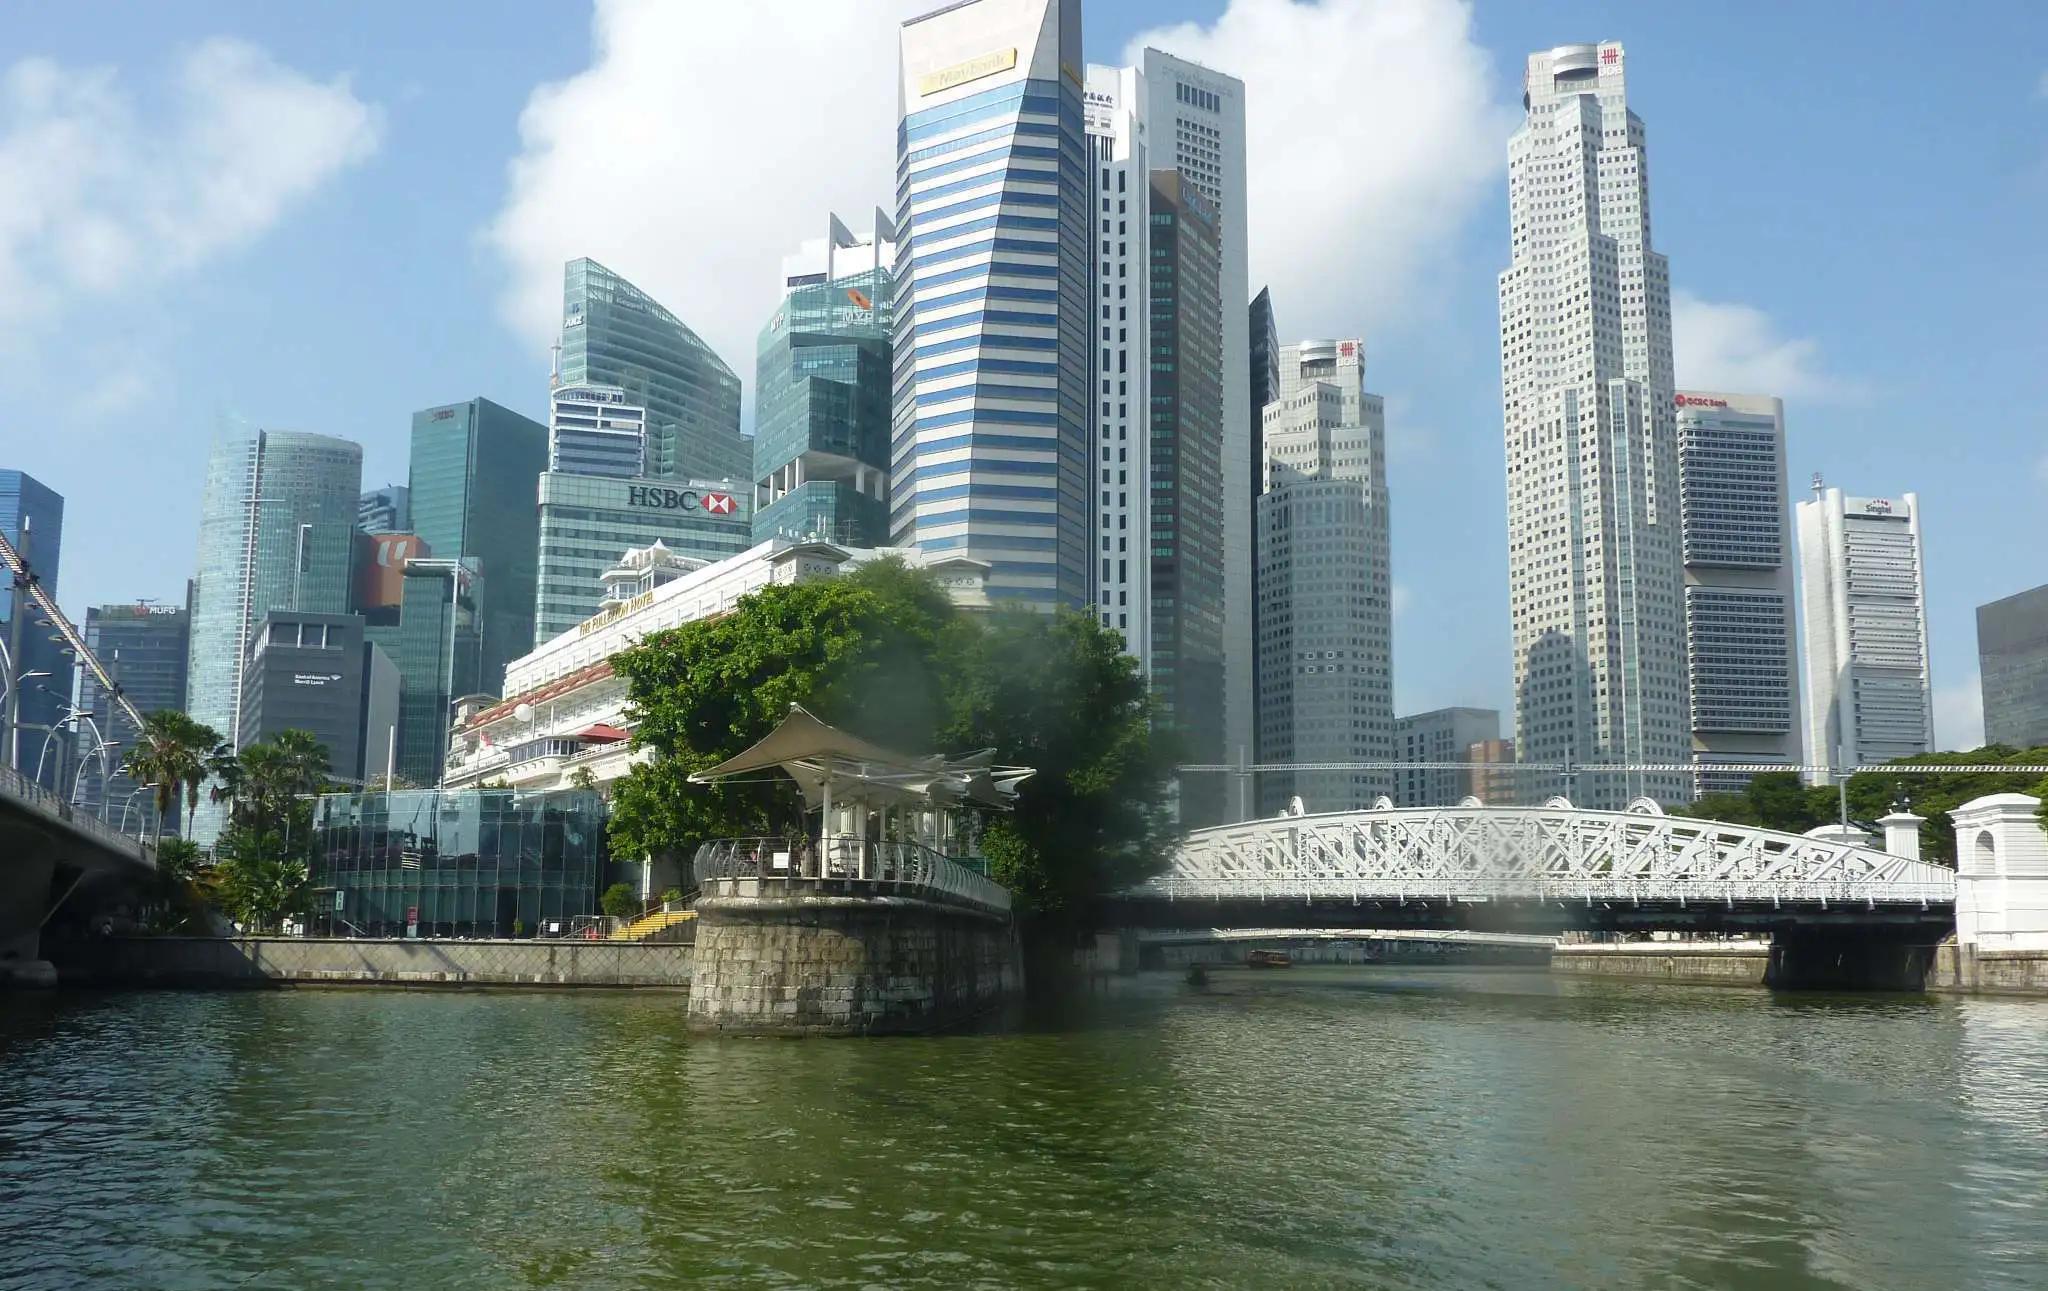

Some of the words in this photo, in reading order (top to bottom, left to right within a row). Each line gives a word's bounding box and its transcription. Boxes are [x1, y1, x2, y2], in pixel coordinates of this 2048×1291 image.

[628, 486, 698, 511] HSBC
[1865, 503, 1892, 515] Singtel
[149, 606, 176, 615] MUFG
